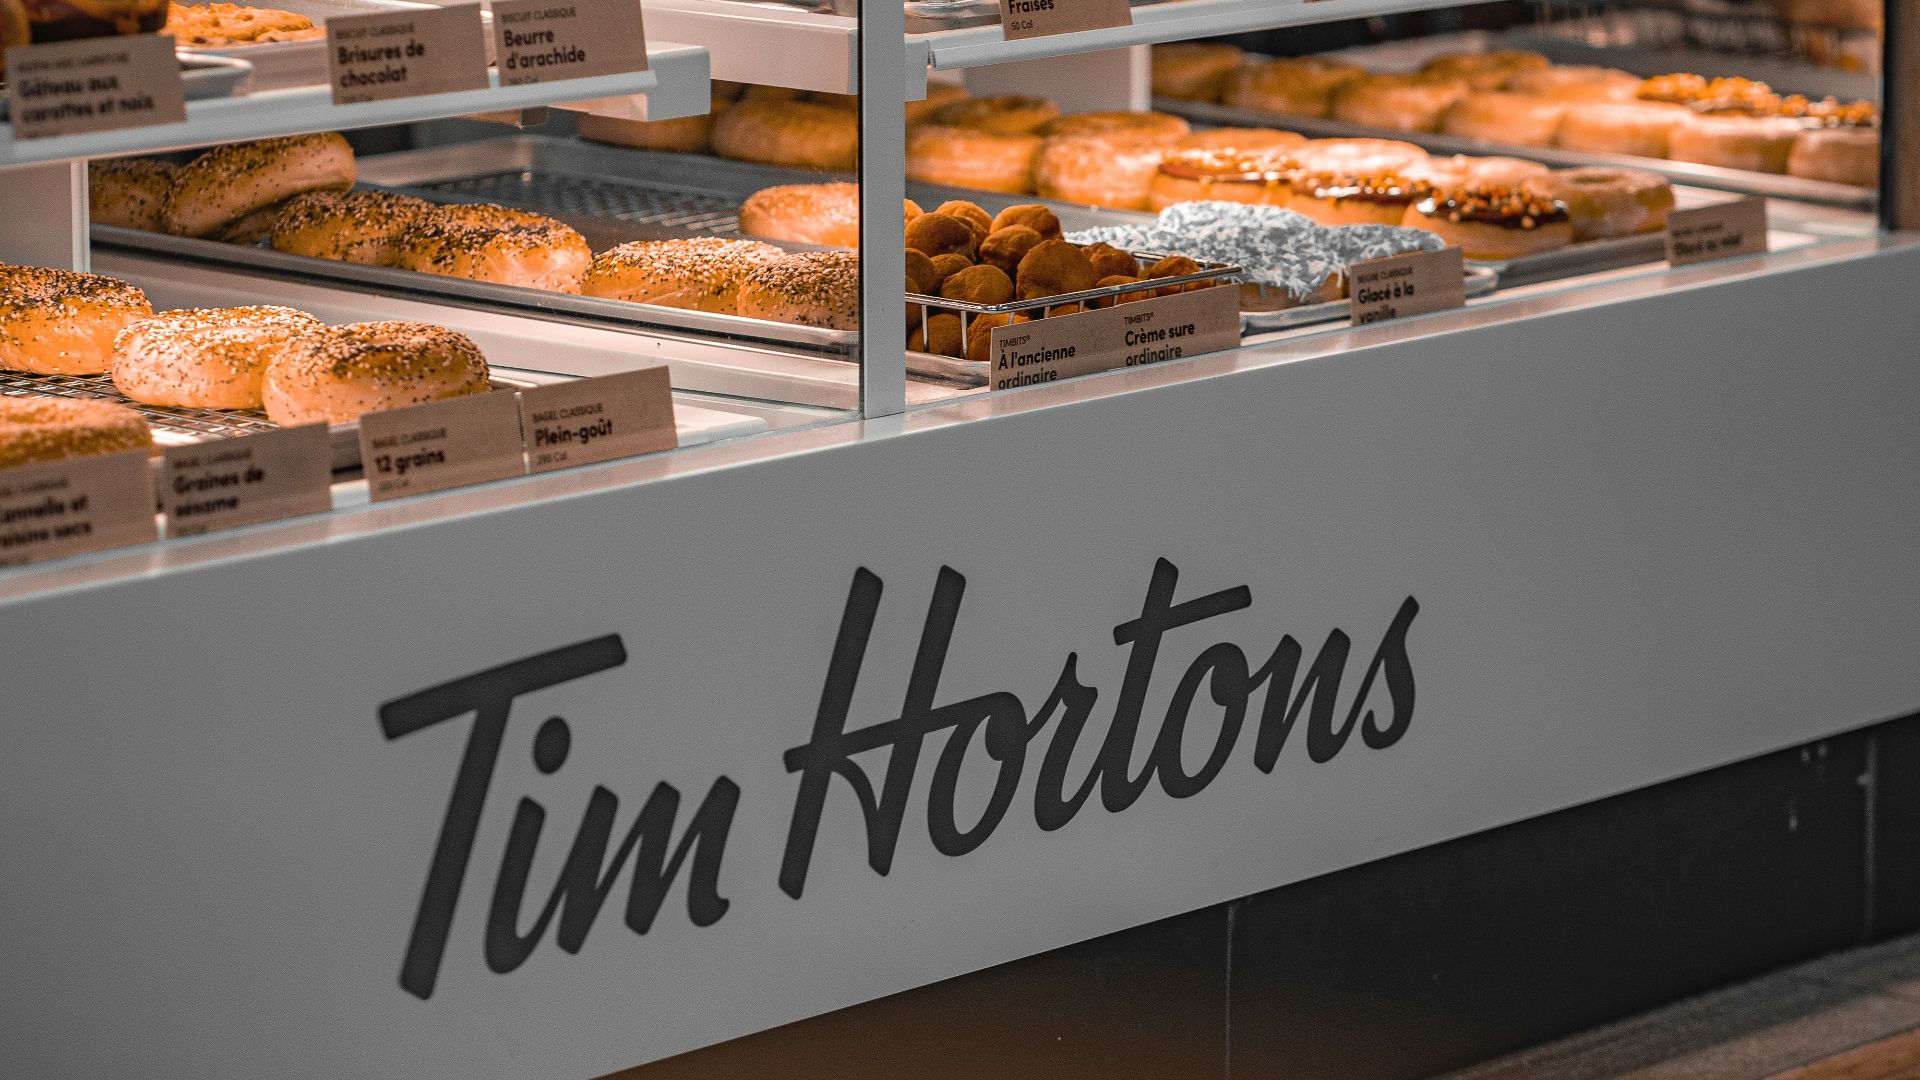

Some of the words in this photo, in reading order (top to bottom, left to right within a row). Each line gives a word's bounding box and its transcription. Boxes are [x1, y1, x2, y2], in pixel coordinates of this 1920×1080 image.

[1008, 0, 1054, 14] Fraises
[1021, 20, 1033, 29] Cal
[504, 29, 554, 47] Beurre
[338, 45, 402, 65] Brisures
[405, 39, 425, 57] de
[506, 45, 585, 69] d'arachide
[340, 66, 407, 88] chocolat
[1358, 283, 1391, 304] Glacé
[1393, 281, 1402, 298] à
[1403, 281, 1415, 295] la
[1360, 304, 1396, 323] vanille
[1125, 327, 1166, 346] Crème
[1168, 323, 1195, 338] sure
[998, 349, 1008, 370] À
[1010, 346, 1076, 368] l'ancienne
[1125, 344, 1182, 366] ordinaire
[998, 368, 1057, 390] ordinaire
[535, 418, 613, 446] Plein-goût
[375, 455, 391, 473] 12
[395, 447, 445, 475] grains
[173, 471, 239, 494] Graines
[243, 464, 265, 484] de
[378, 633, 741, 1001] Tim
[778, 557, 1419, 900] Hortons
